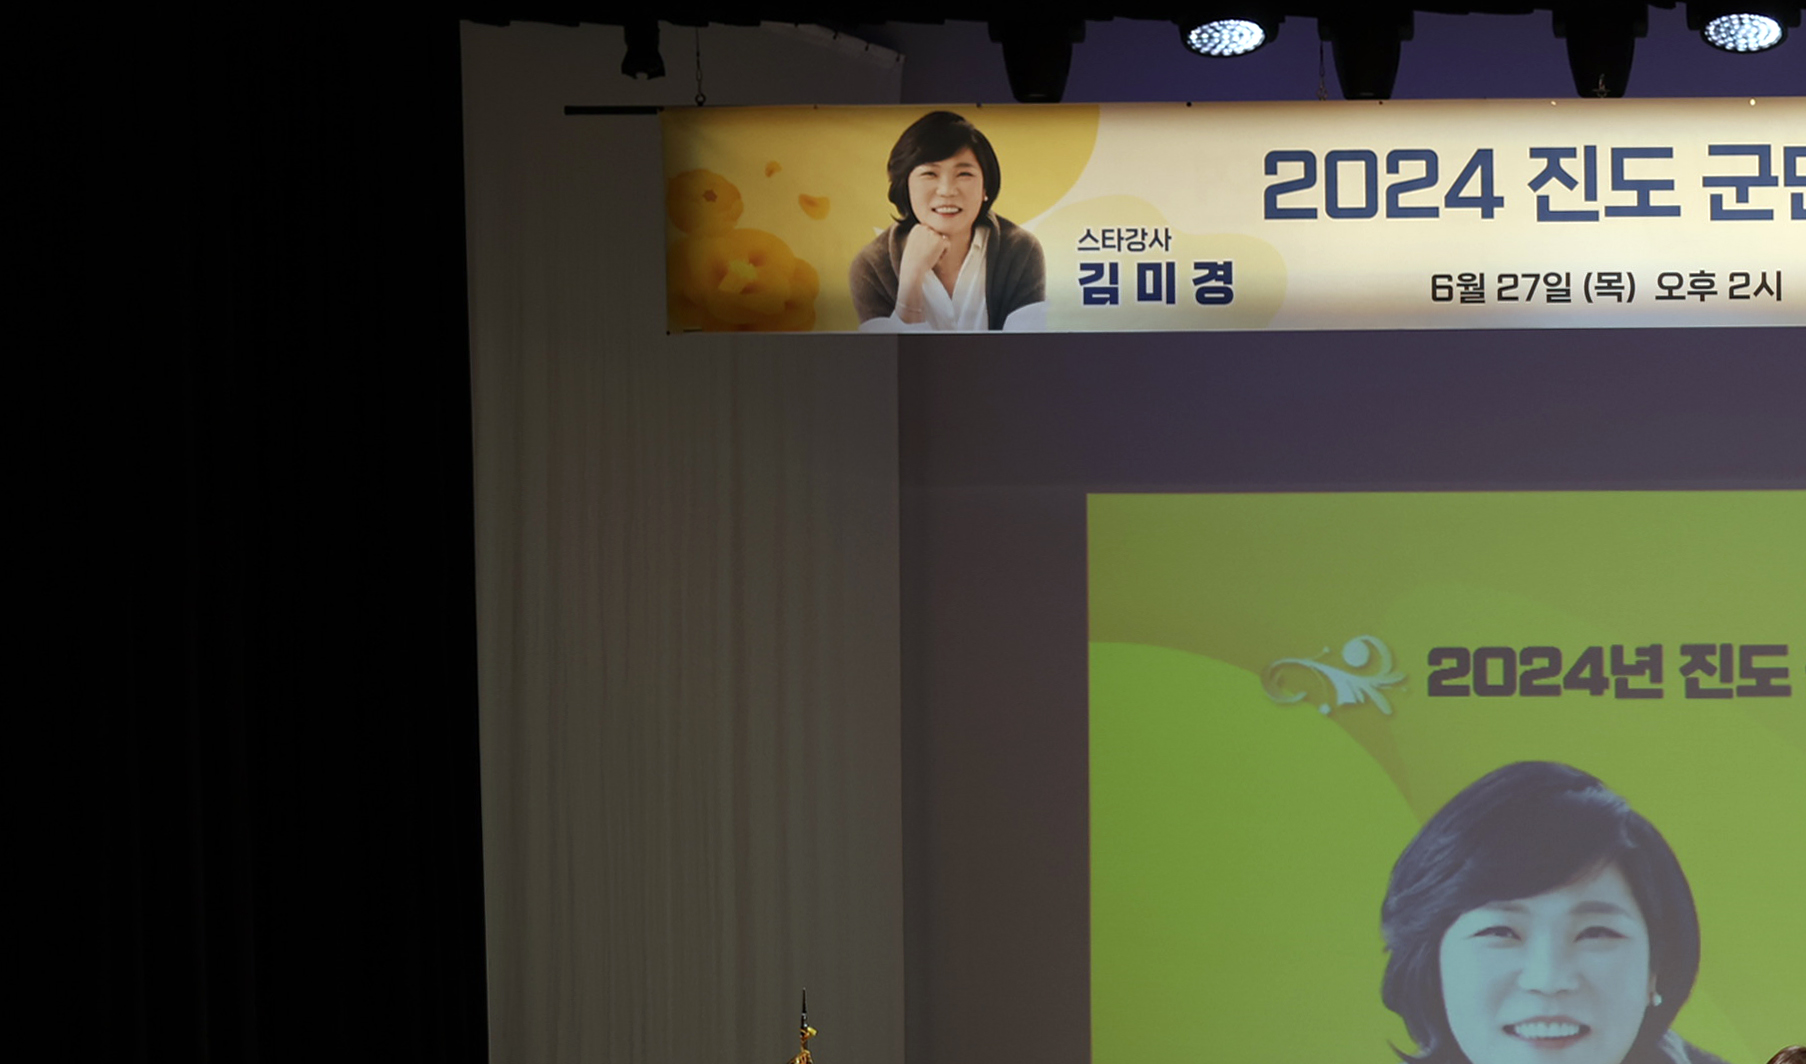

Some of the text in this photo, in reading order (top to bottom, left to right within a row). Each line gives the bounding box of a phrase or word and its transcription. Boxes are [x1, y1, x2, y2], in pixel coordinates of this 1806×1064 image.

[1263, 148, 1504, 220] 2024
[1527, 144, 1682, 222] 진도
[1077, 227, 1172, 253] 스타강사
[1430, 269, 1784, 305] 6월 27일 (목) 오후 2시
[1426, 643, 1664, 700] 2024년
[1678, 642, 1792, 700] 진도
